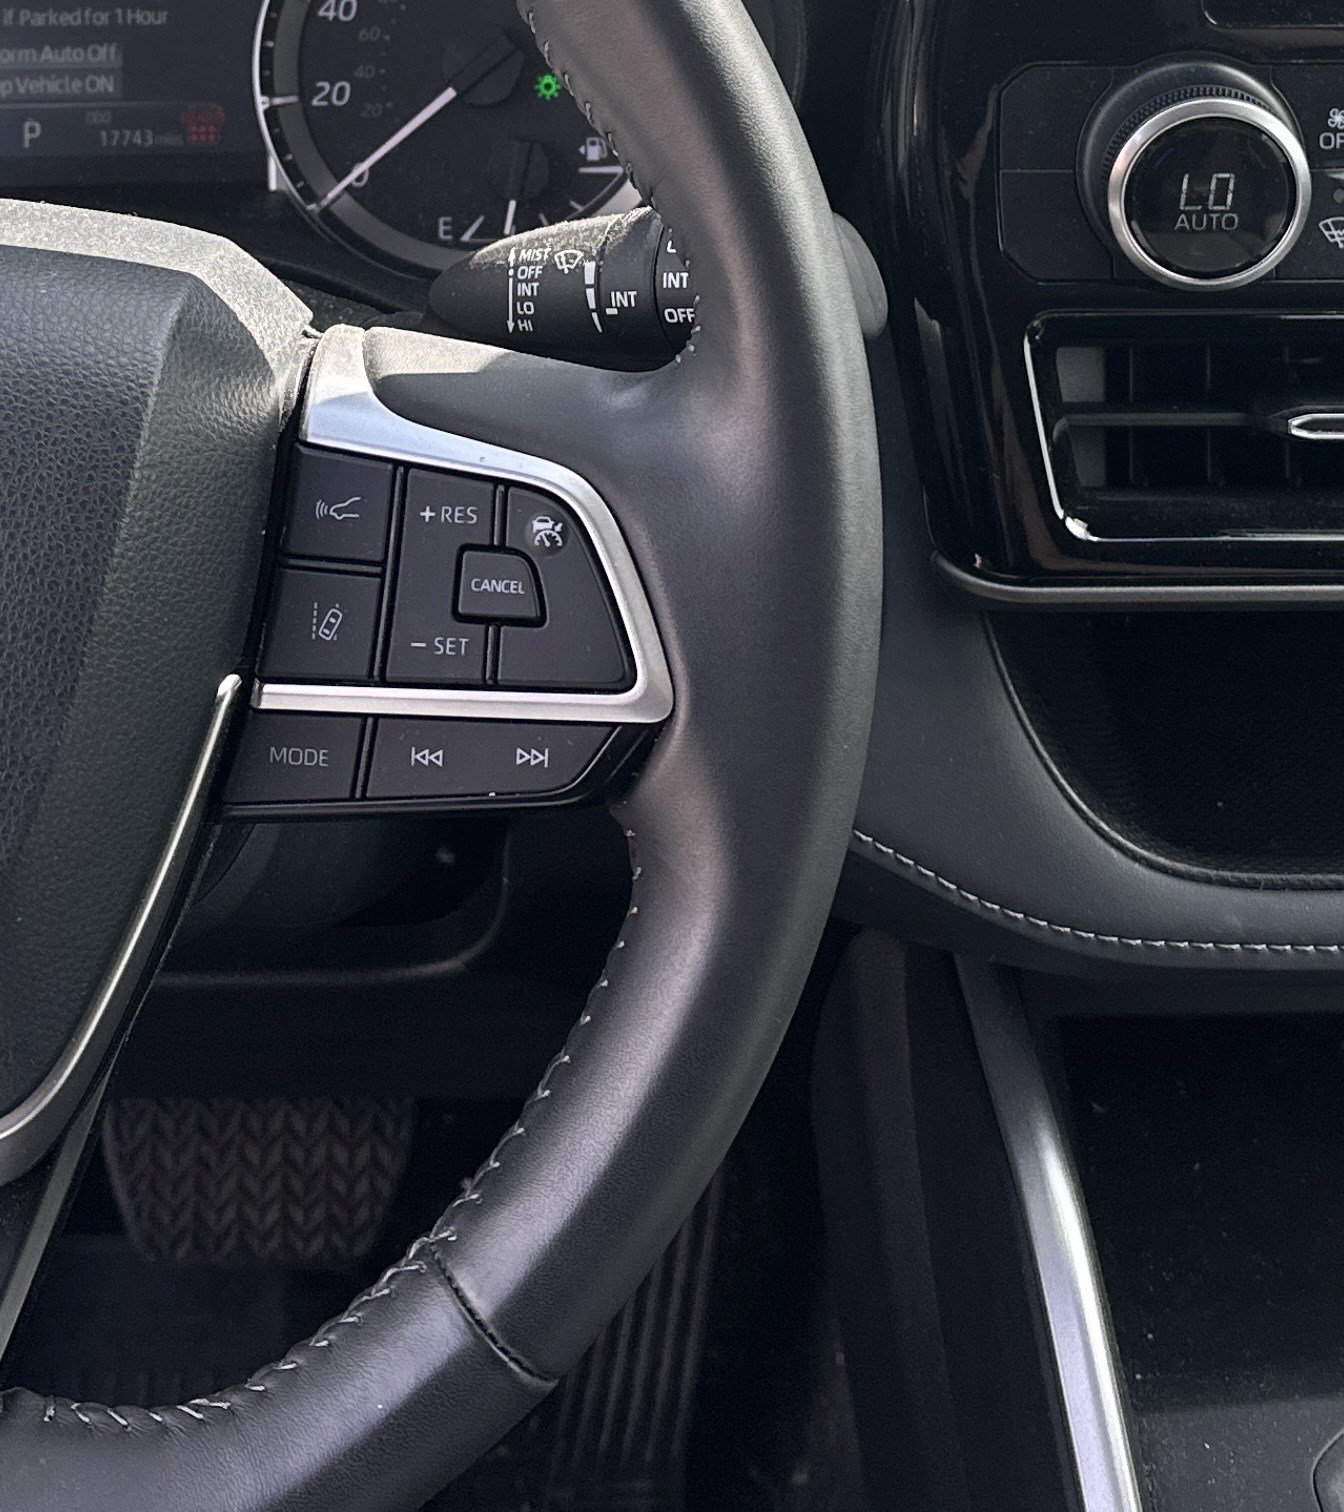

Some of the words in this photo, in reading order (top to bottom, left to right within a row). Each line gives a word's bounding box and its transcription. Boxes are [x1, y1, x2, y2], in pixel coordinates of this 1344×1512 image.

[18, 8, 82, 27] Parked
[84, 7, 111, 26] for
[127, 7, 169, 26] Hour
[358, 25, 381, 41] 60
[39, 44, 84, 63] Auto
[86, 42, 117, 62] Off
[354, 64, 376, 79] 40
[14, 75, 83, 95] Vehicle
[85, 74, 114, 94] ON
[311, 80, 351, 107] 20
[360, 102, 383, 118] 20
[23, 118, 43, 149] P
[101, 129, 155, 147] 17743
[1179, 173, 1235, 211] LO
[438, 217, 453, 239] E
[1174, 213, 1239, 231] AUTO
[519, 247, 552, 262] MIST
[517, 265, 544, 280] OFF
[663, 272, 690, 289] INT
[517, 282, 540, 297] INT
[516, 301, 535, 316] LO
[611, 291, 638, 308] INT
[517, 318, 534, 332] HI
[664, 308, 696, 324] OFF
[470, 578, 526, 596] CANCEL
[433, 637, 470, 656] SET
[269, 746, 330, 768] MODE
